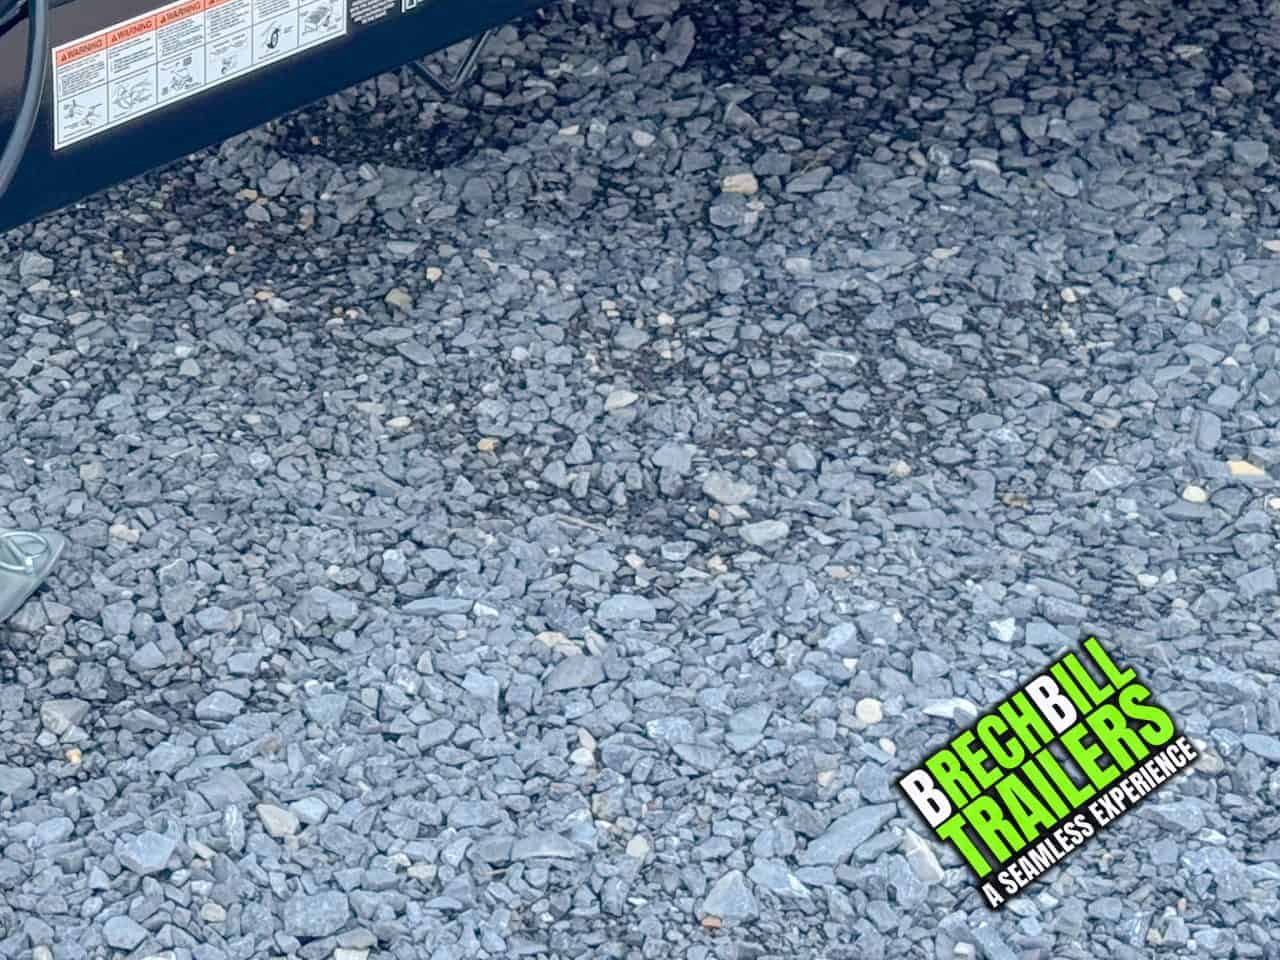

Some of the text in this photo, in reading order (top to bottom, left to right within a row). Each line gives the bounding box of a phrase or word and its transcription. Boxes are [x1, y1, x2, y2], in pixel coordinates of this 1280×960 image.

[166, 1, 201, 22] WARNING
[116, 19, 153, 42] WARNING
[66, 39, 104, 60] WARNING
